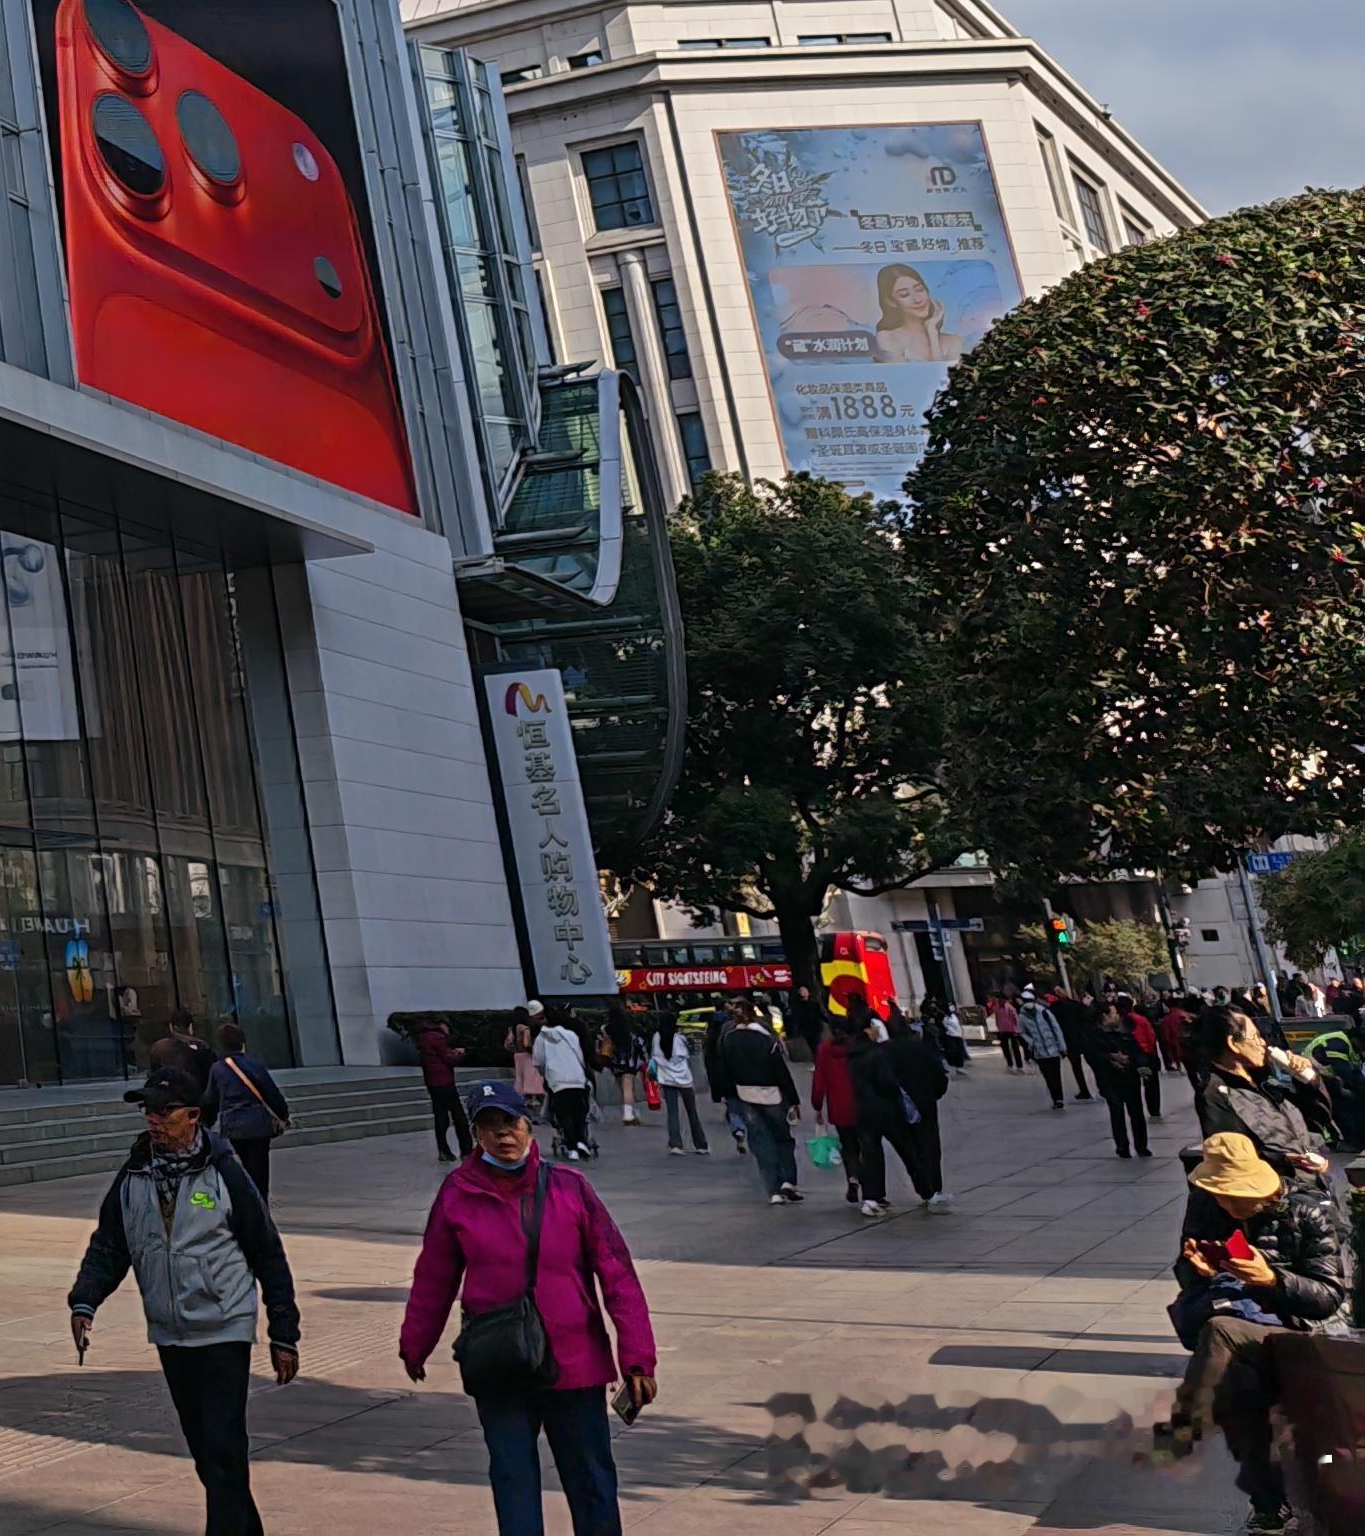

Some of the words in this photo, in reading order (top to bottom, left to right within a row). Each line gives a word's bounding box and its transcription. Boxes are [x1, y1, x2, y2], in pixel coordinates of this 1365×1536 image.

[517, 718, 593, 985] 恒基名人购物中心
[646, 971, 665, 986] CITY
[668, 970, 728, 986] SIGHTSEEING
